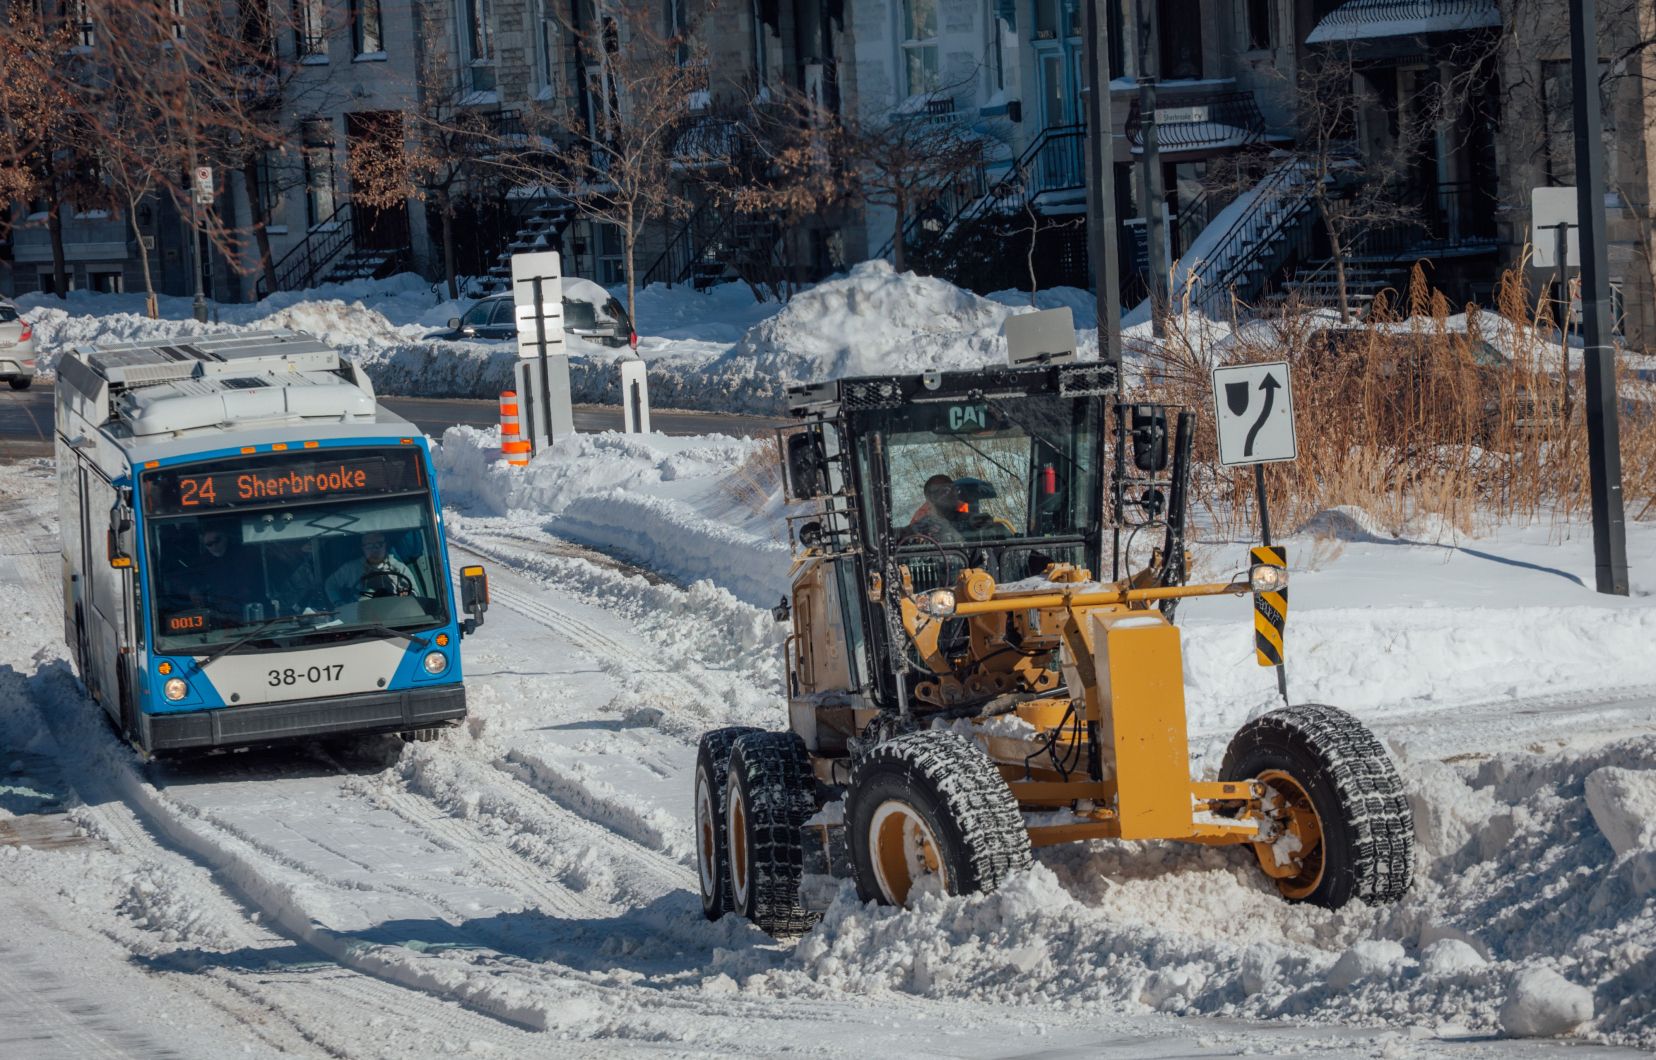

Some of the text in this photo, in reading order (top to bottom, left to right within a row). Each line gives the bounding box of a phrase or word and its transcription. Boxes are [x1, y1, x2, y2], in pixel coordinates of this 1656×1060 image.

[950, 405, 988, 430] CAT
[180, 466, 367, 506] 24 Sherbrooke
[171, 615, 203, 629] 0013
[268, 664, 344, 687] 38-017
